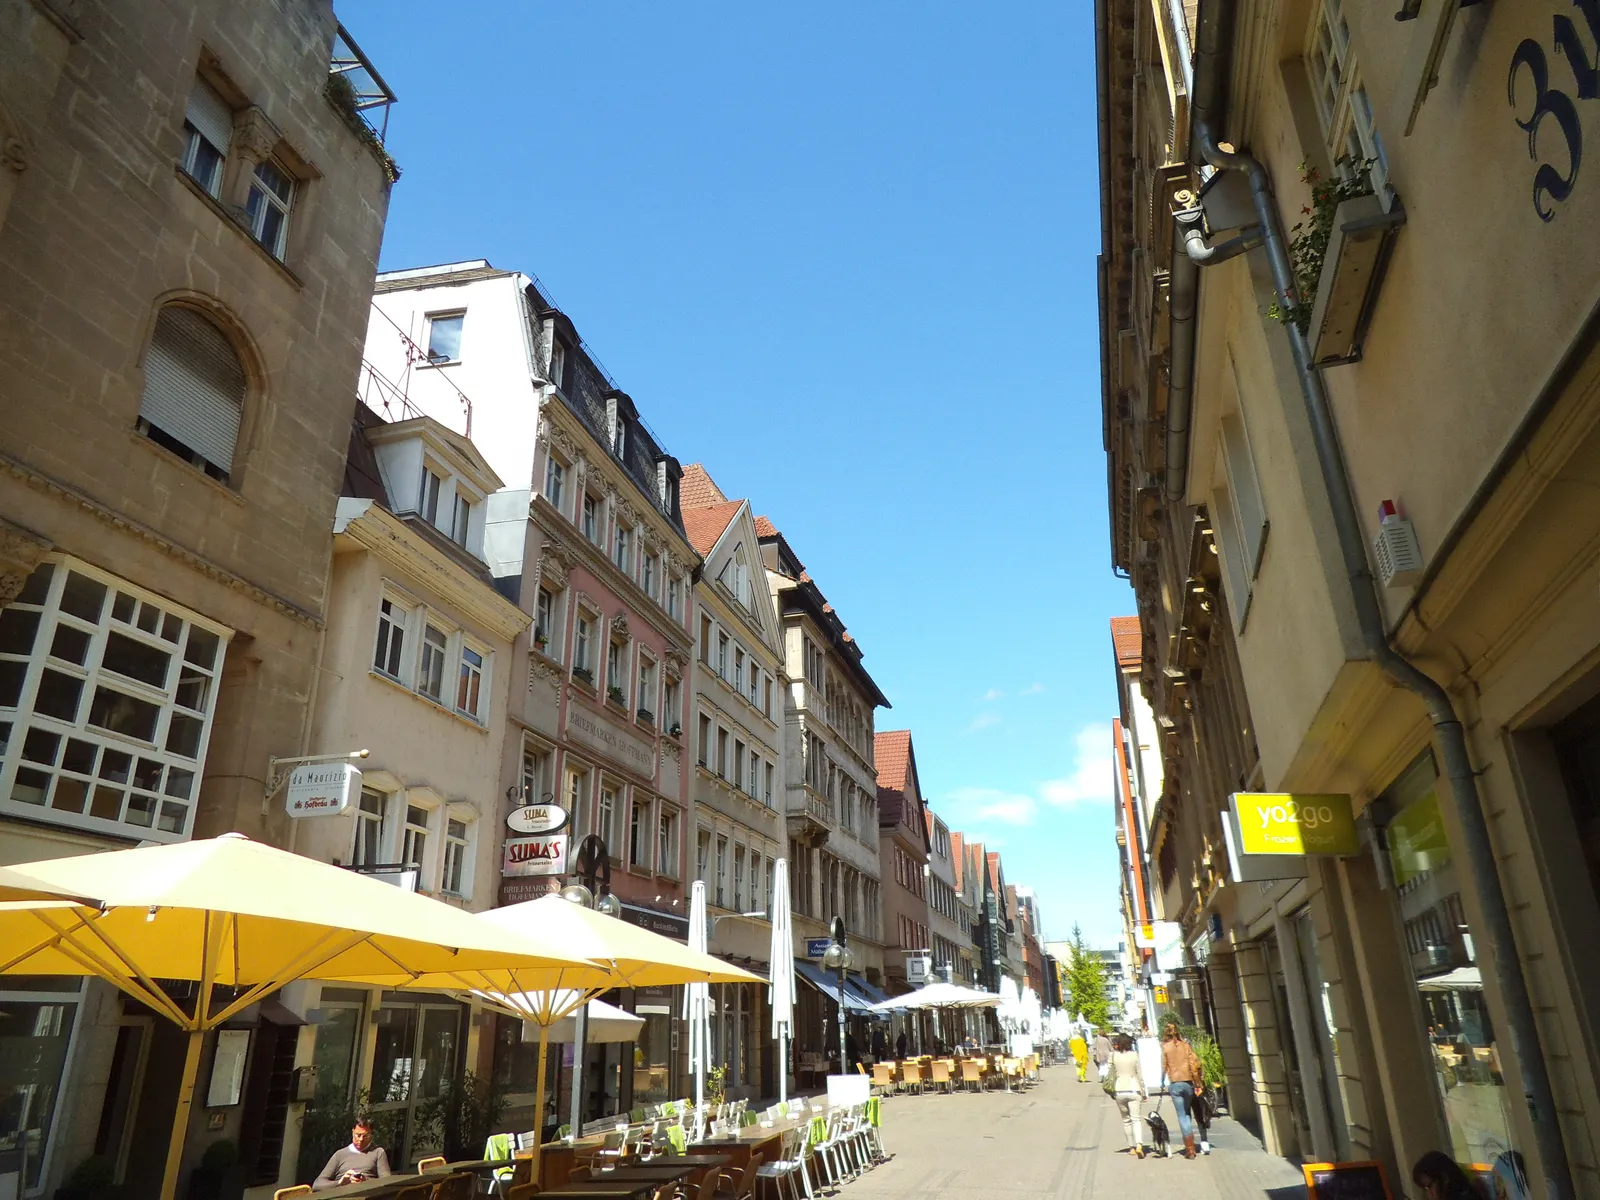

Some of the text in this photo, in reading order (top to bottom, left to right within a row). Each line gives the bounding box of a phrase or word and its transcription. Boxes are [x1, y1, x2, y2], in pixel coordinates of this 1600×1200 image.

[570, 712, 617, 747] BRIEFMARKEN
[292, 770, 348, 785] da Maurizio
[523, 808, 548, 821] SUNA
[1256, 801, 1333, 829] yo2go
[508, 842, 561, 863] SUNA'S
[503, 884, 556, 893] BRIEFMARKEN
